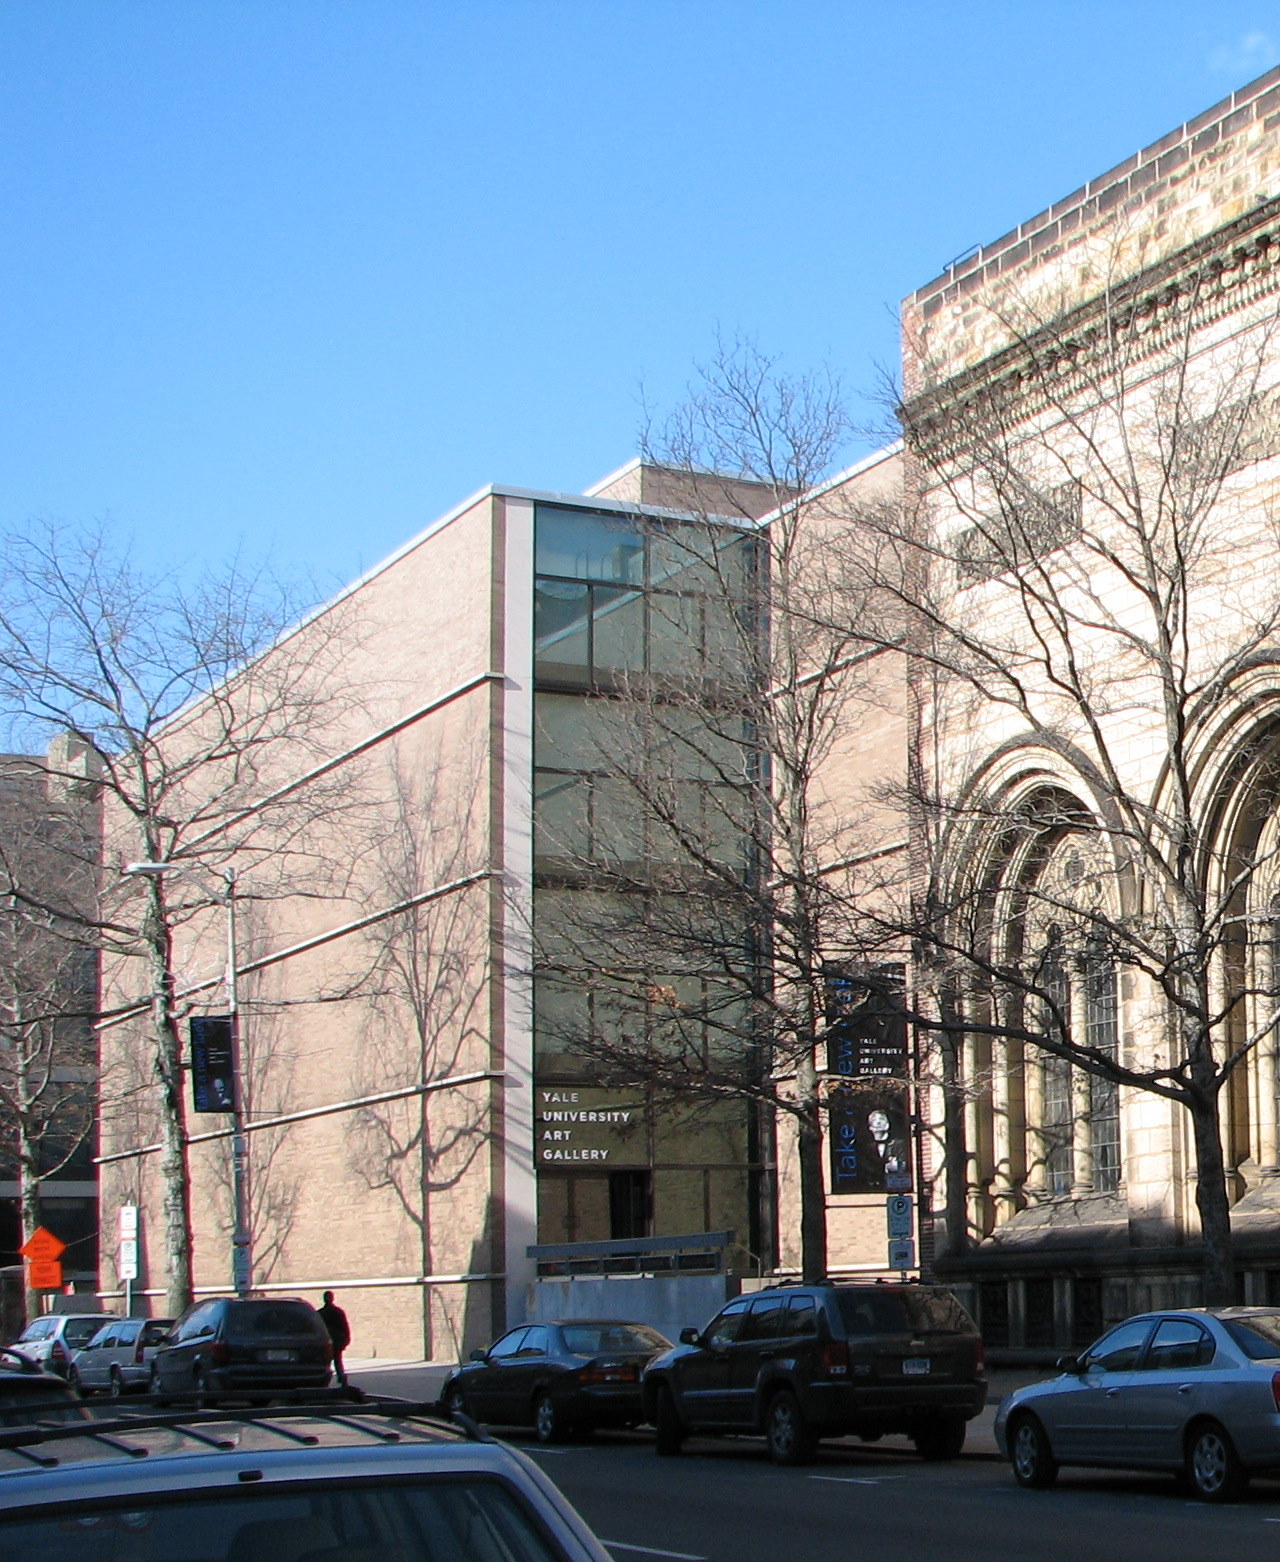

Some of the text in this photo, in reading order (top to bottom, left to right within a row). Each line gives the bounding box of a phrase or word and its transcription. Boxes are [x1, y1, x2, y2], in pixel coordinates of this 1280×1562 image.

[542, 1092, 579, 1103] YALE
[543, 1112, 630, 1122] UNIVERSITY
[543, 1130, 572, 1141] ART
[543, 1149, 609, 1160] GALLERY
[835, 1124, 857, 1184] Take
